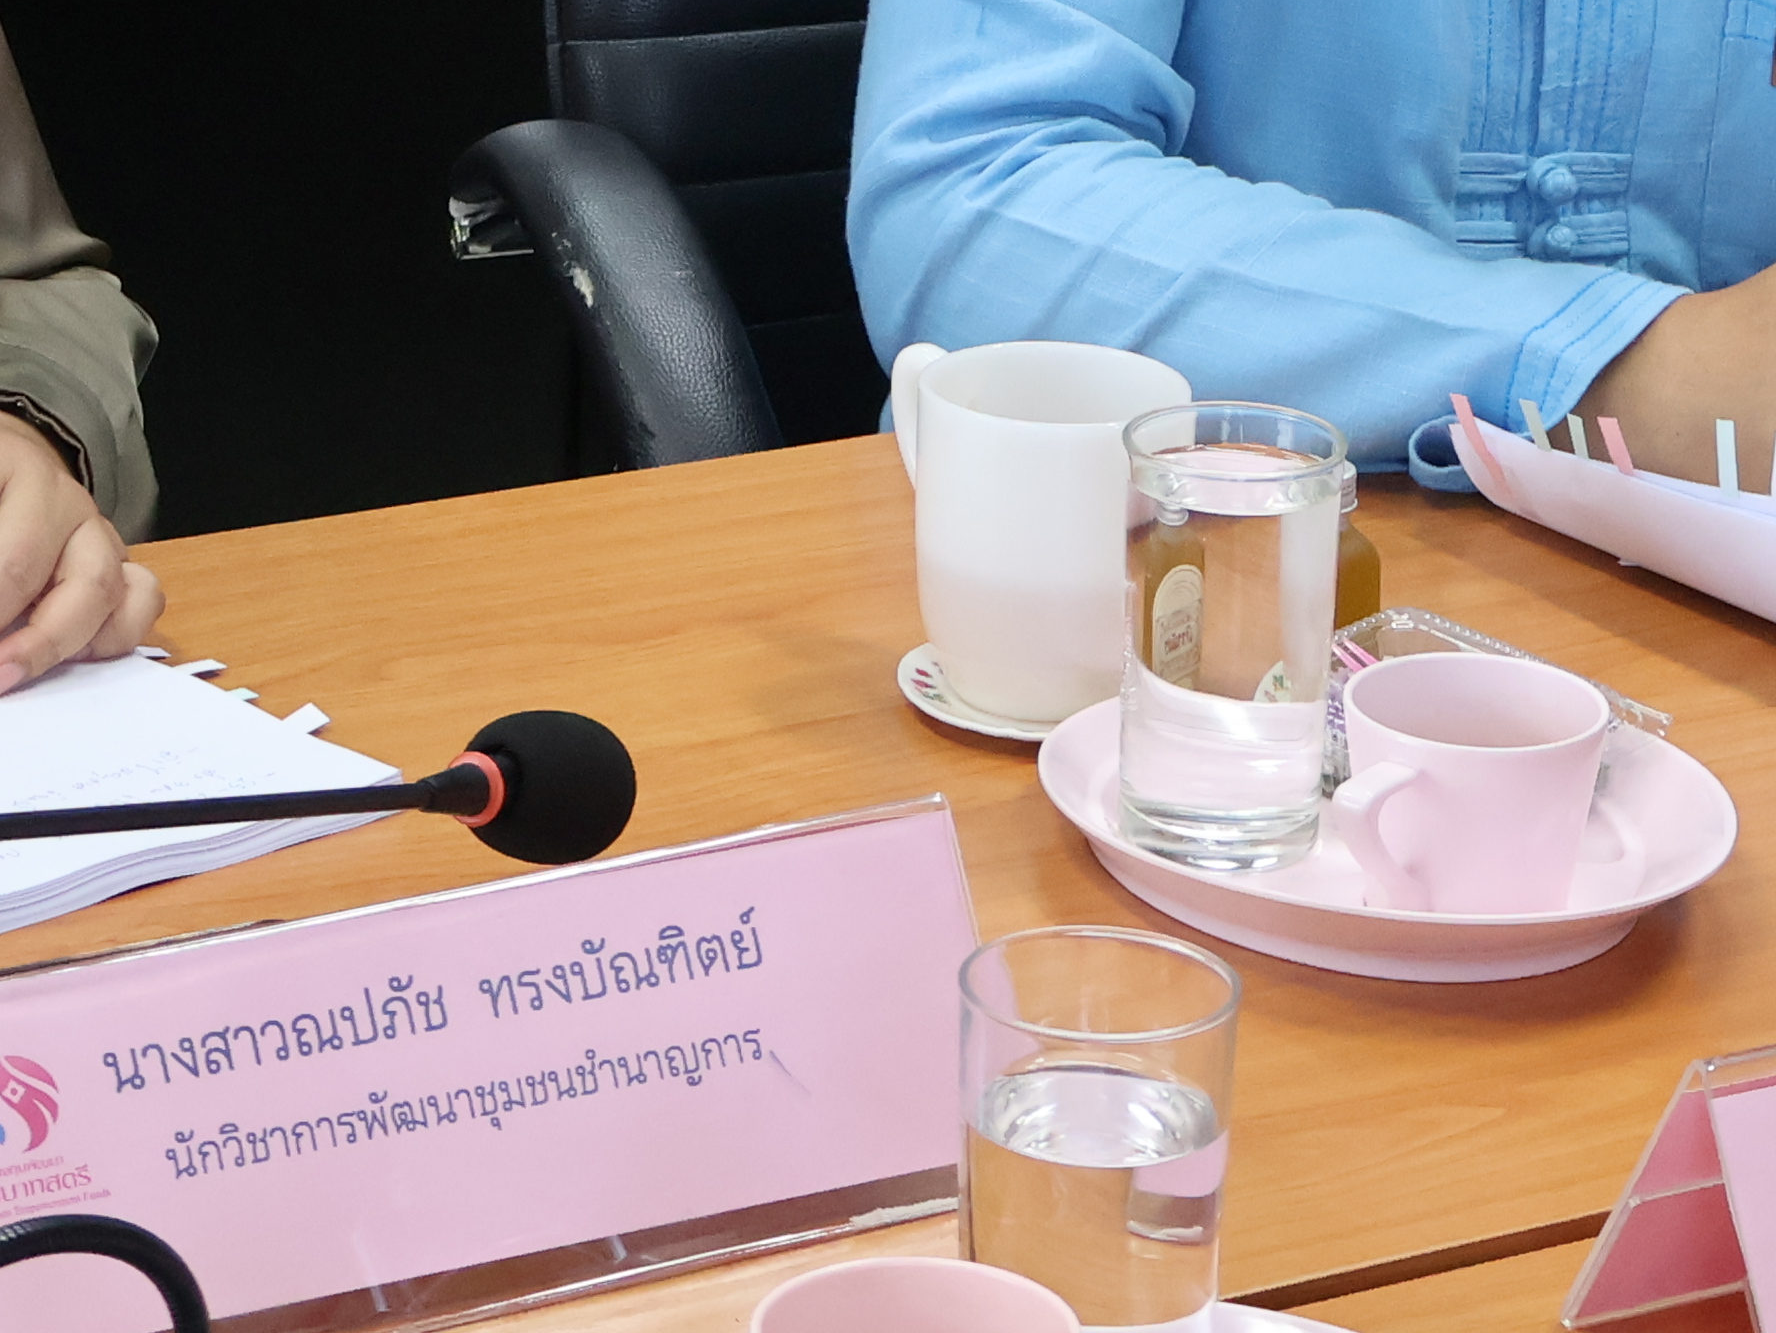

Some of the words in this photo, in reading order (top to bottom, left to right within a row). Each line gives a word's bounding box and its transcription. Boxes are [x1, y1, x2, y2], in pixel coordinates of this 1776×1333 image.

[102, 973, 450, 1094] นางสาวณปภัช
[478, 906, 765, 1020] ทรงบัณฑิตย์
[165, 1027, 764, 1180] นักวิชาการพัฒนาชุมชนชำนาญการ
